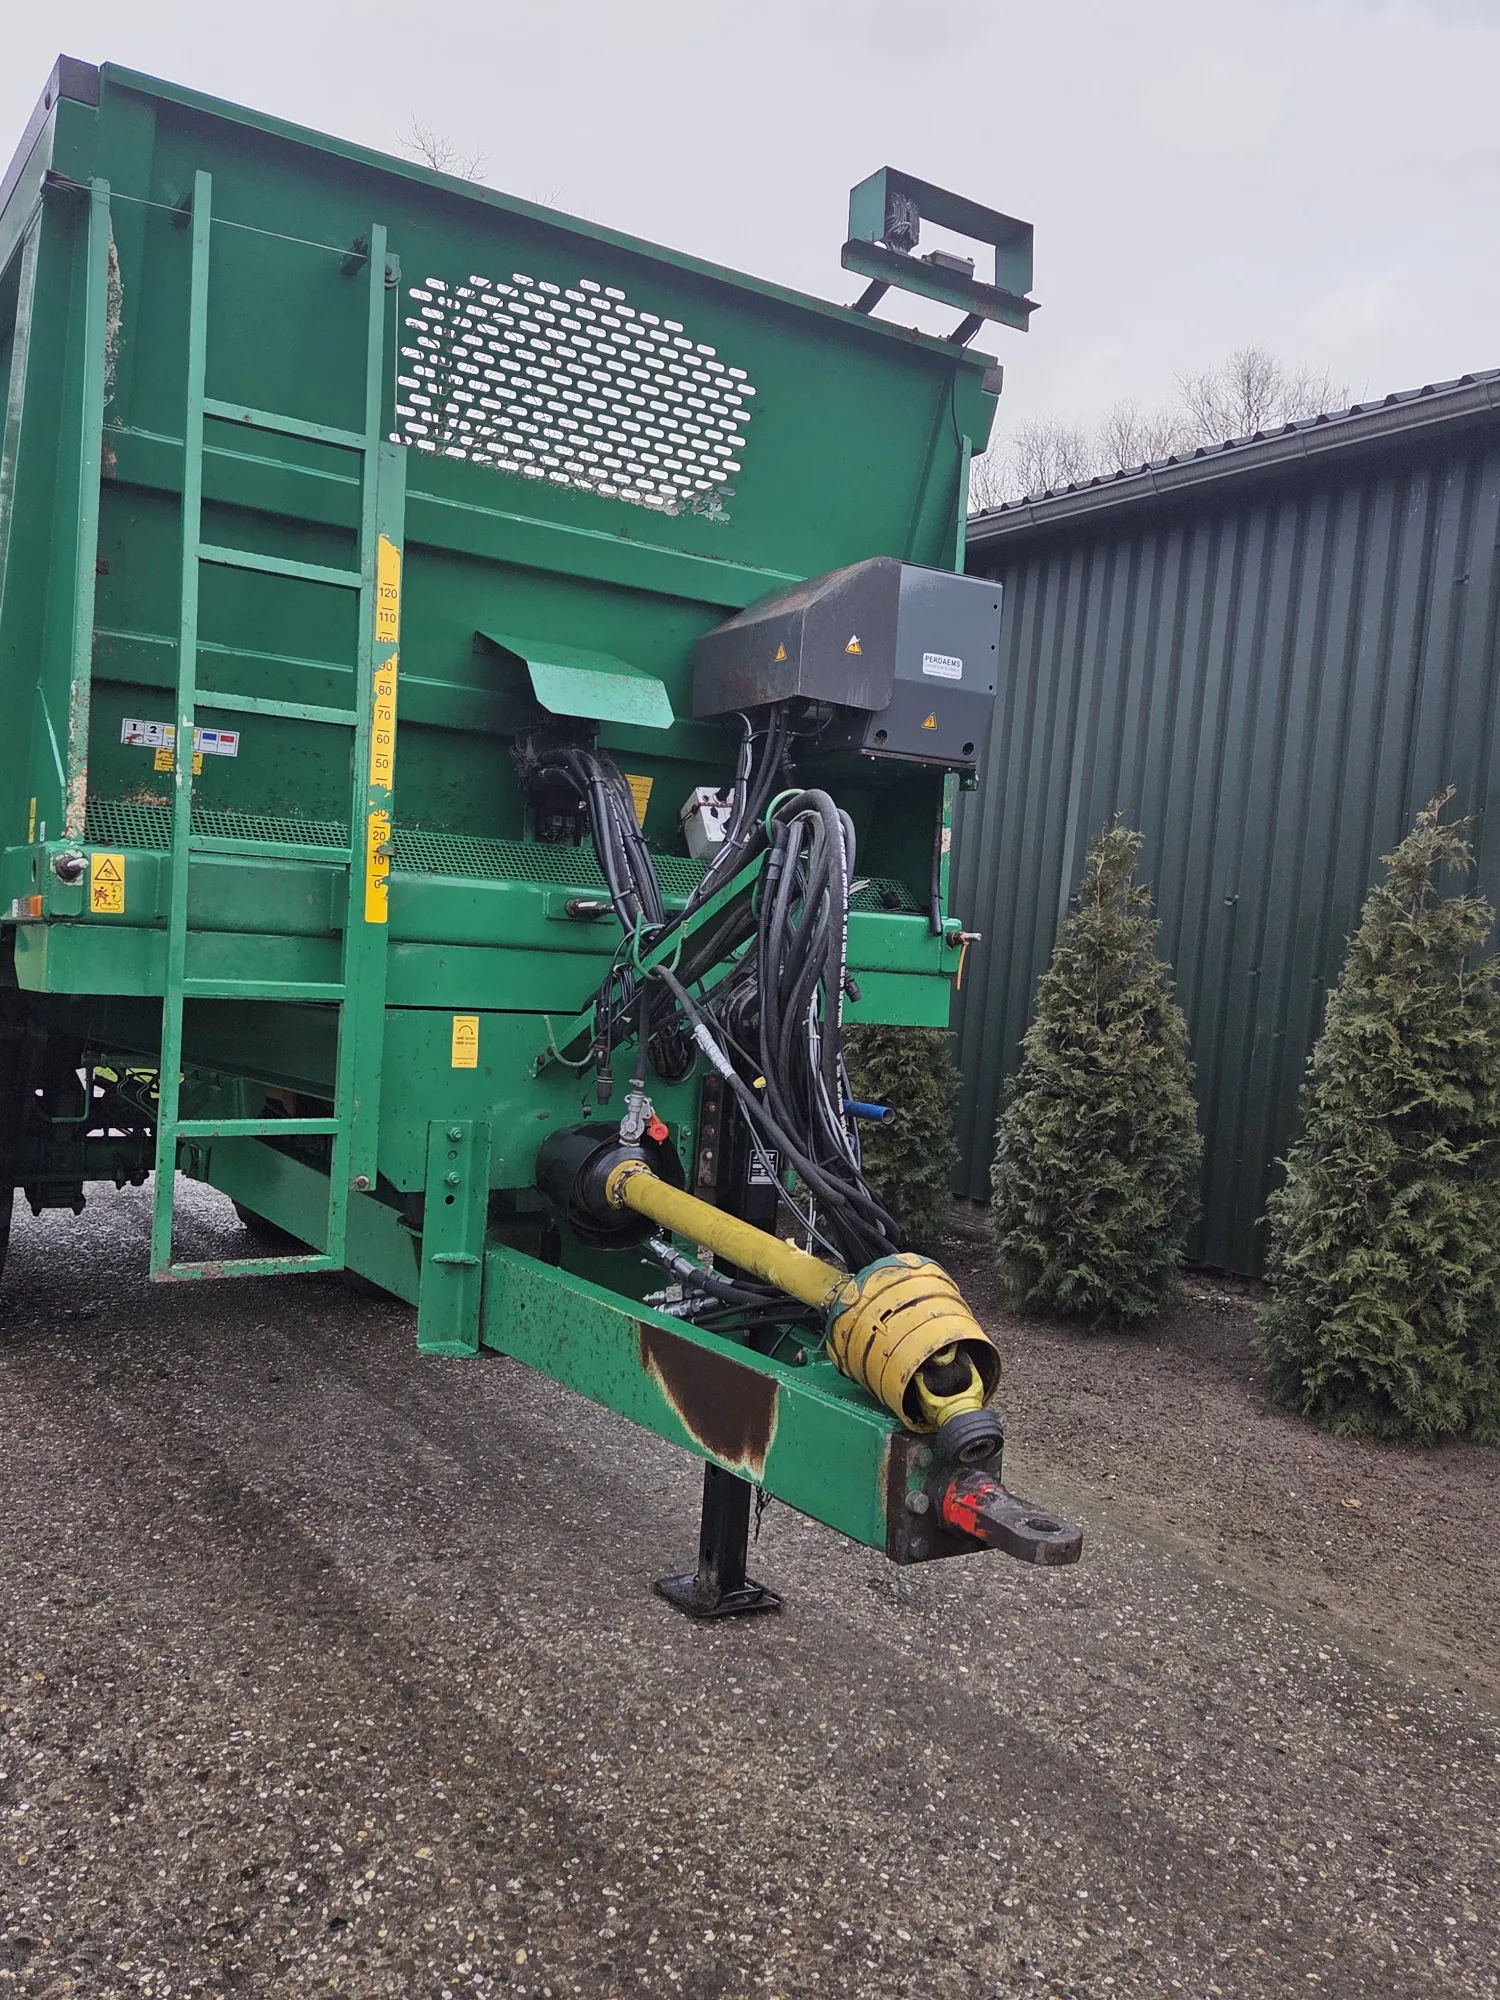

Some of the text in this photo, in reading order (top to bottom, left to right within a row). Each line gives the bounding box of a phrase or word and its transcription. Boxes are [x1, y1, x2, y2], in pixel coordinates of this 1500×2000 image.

[380, 588, 398, 599] 120
[379, 612, 396, 623] 110
[926, 655, 961, 668] PERDAEMS
[378, 685, 392, 696] 80
[377, 710, 391, 720] 70
[132, 723, 157, 734] 1 2
[376, 734, 390, 744] 60
[375, 758, 389, 769] 50
[373, 831, 386, 841] 20
[373, 856, 385, 865] 10
